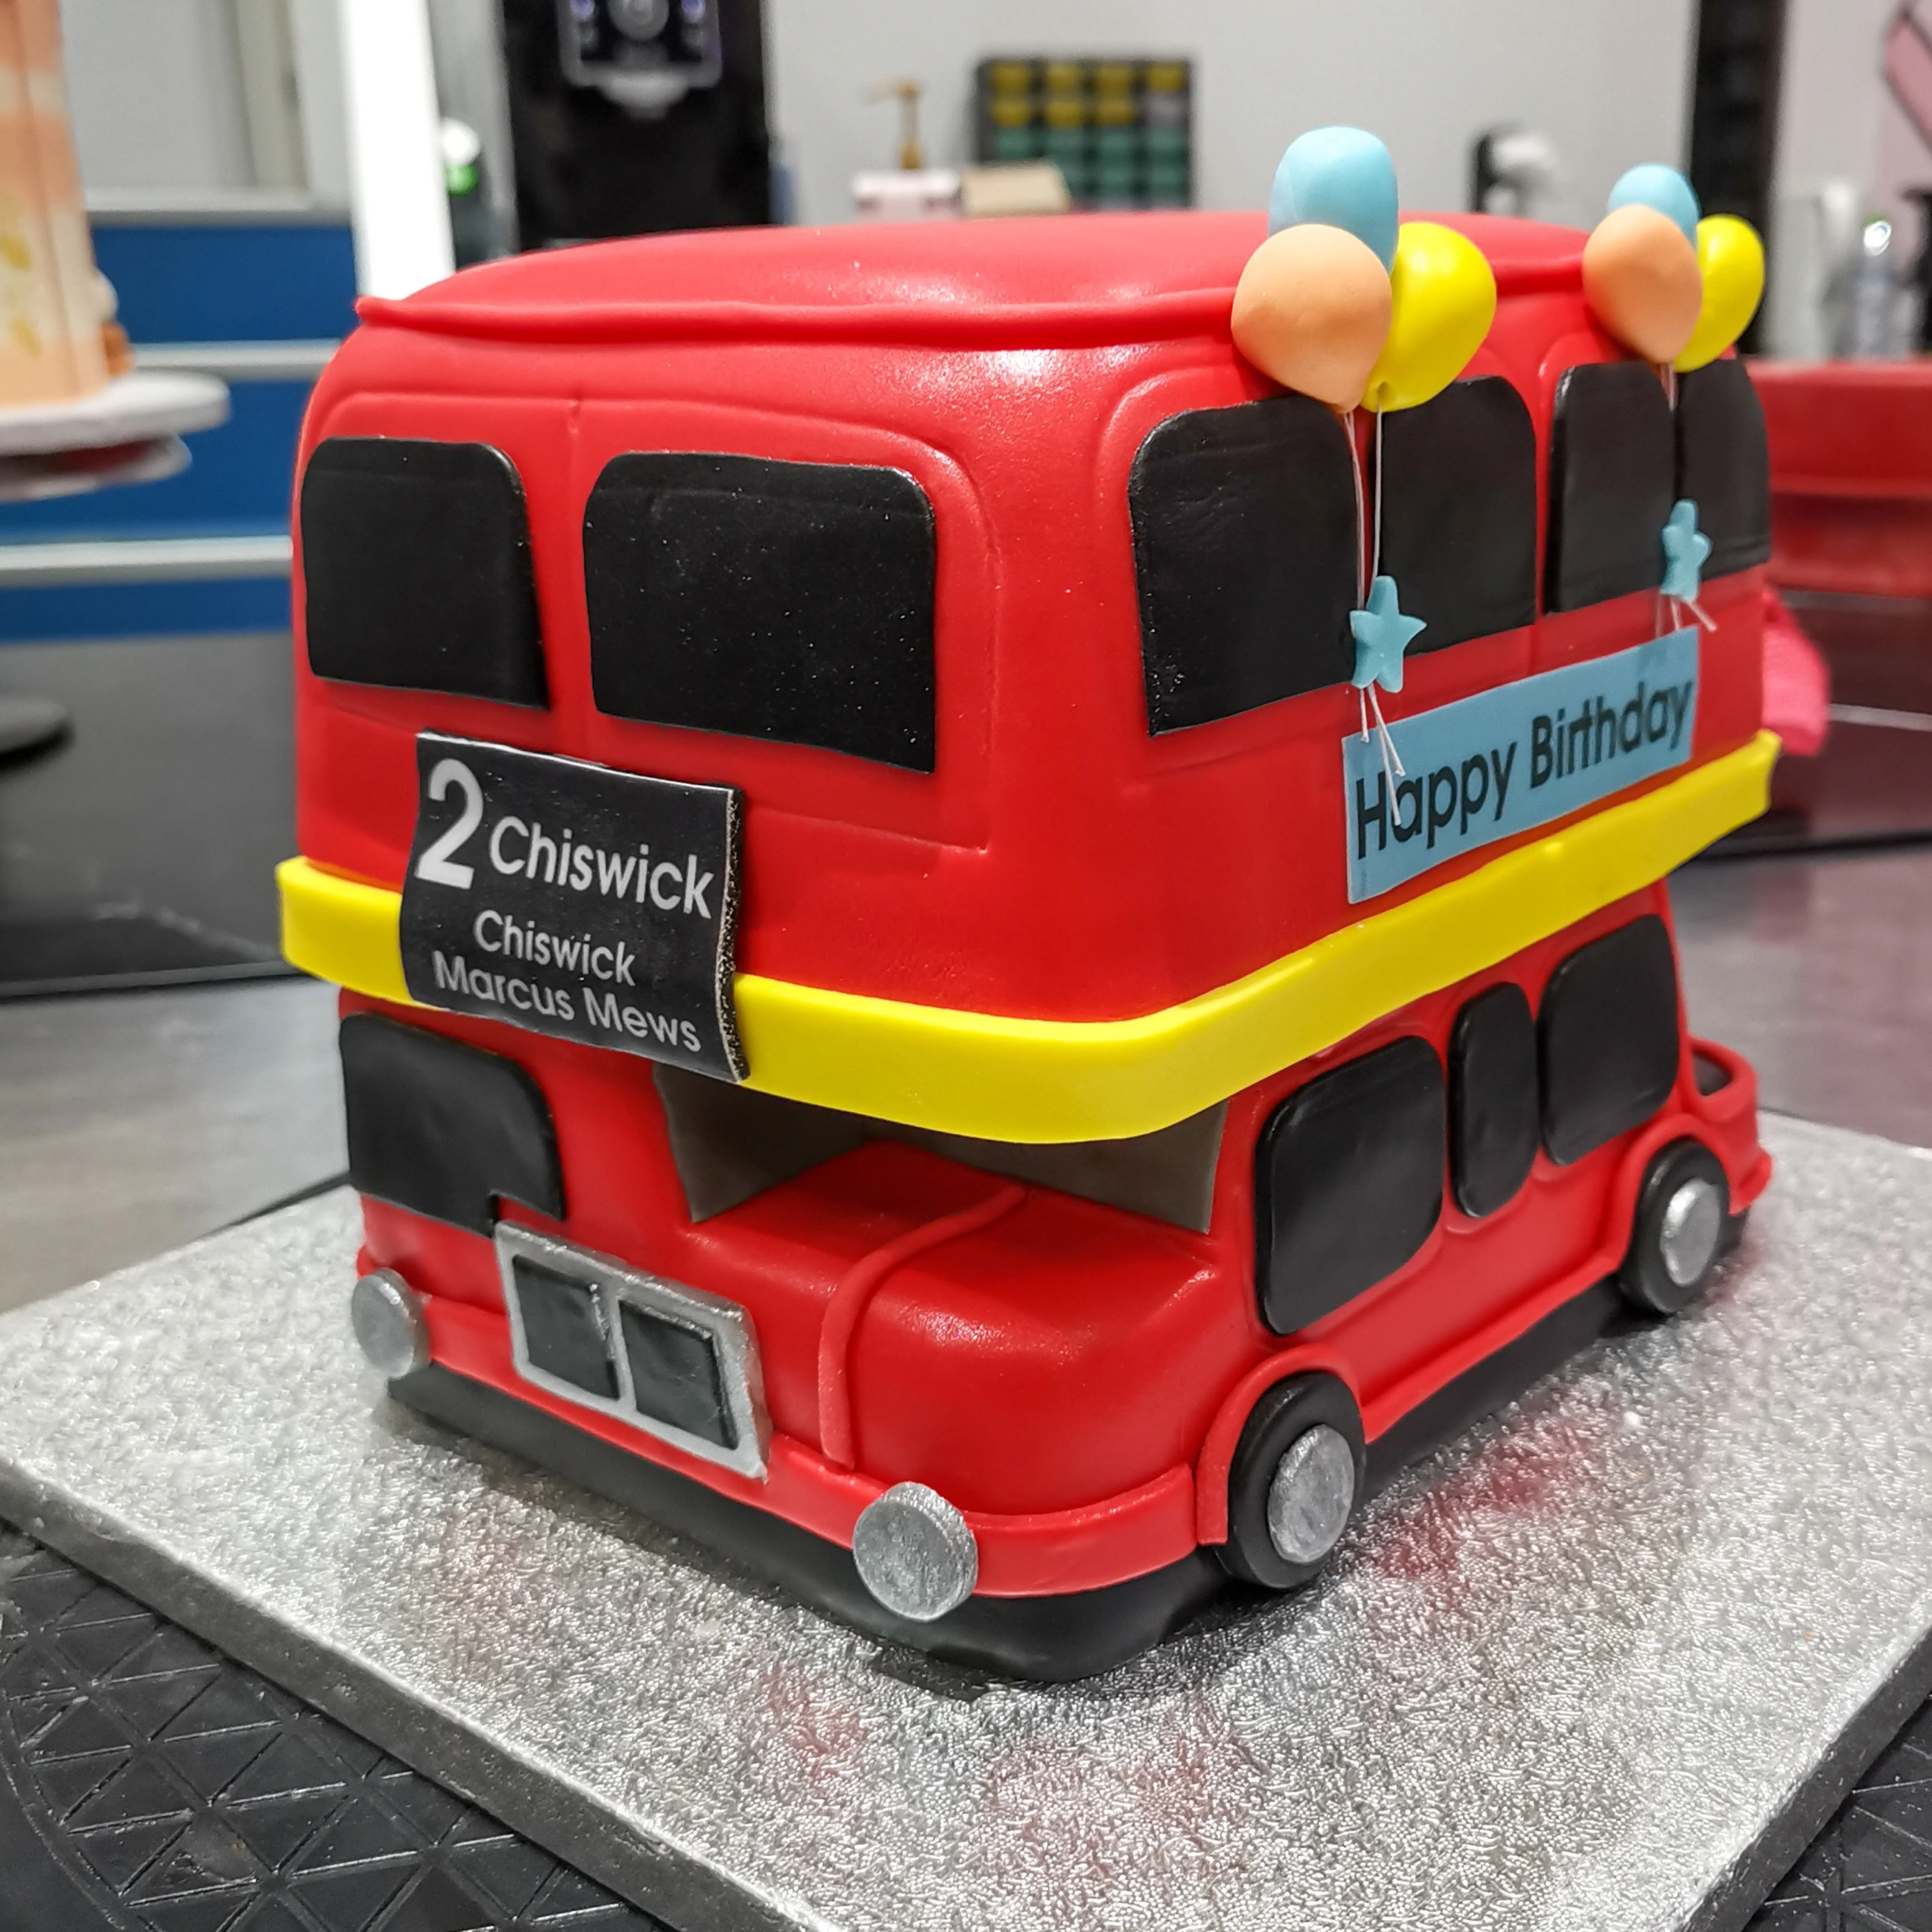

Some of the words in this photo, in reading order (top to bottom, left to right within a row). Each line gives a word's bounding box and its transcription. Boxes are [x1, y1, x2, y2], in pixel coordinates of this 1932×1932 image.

[1356, 741, 1517, 860] Happy
[1530, 681, 1691, 790] Birthday
[414, 758, 483, 890] 2
[489, 816, 715, 919] Chiswick
[432, 950, 575, 1021] Marcus
[583, 986, 701, 1052] Mews
[473, 909, 636, 987] Chiswick
